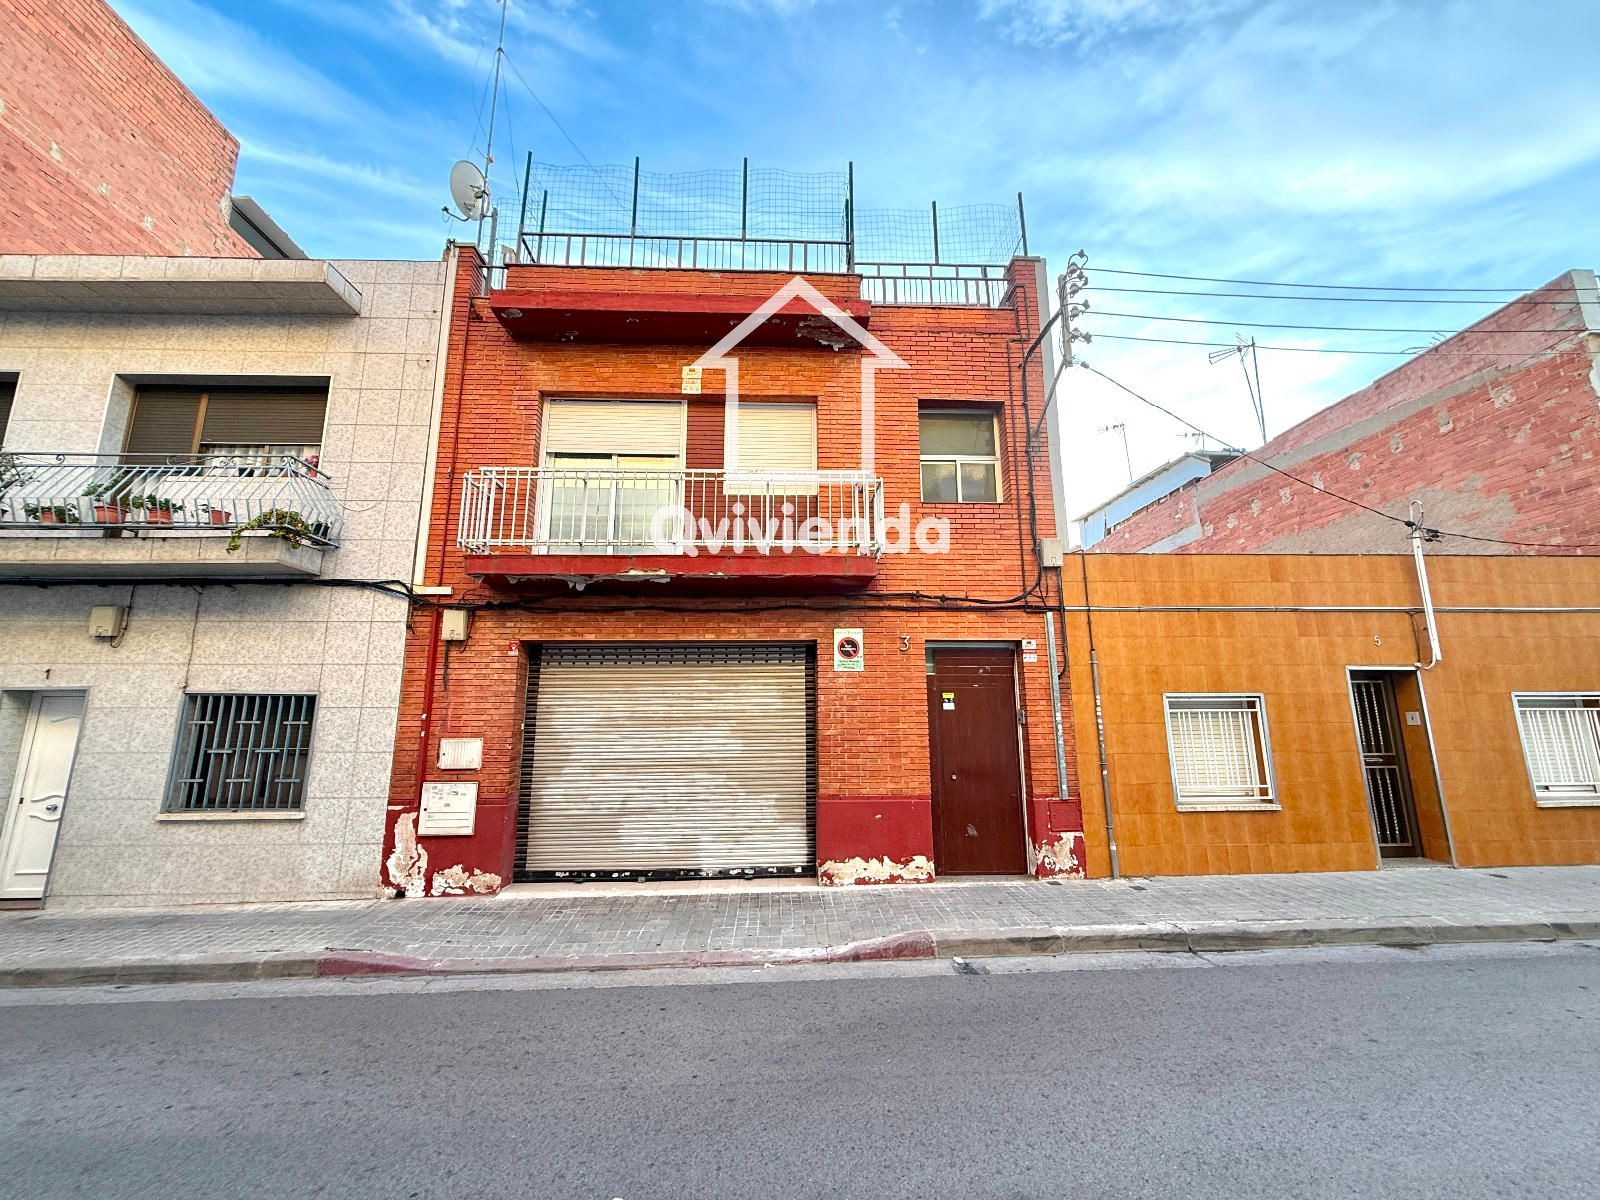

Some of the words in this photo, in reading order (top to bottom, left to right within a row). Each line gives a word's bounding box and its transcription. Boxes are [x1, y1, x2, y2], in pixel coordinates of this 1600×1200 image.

[899, 635, 911, 651] 3
[1373, 635, 1382, 647] 5
[44, 668, 52, 680] 1
